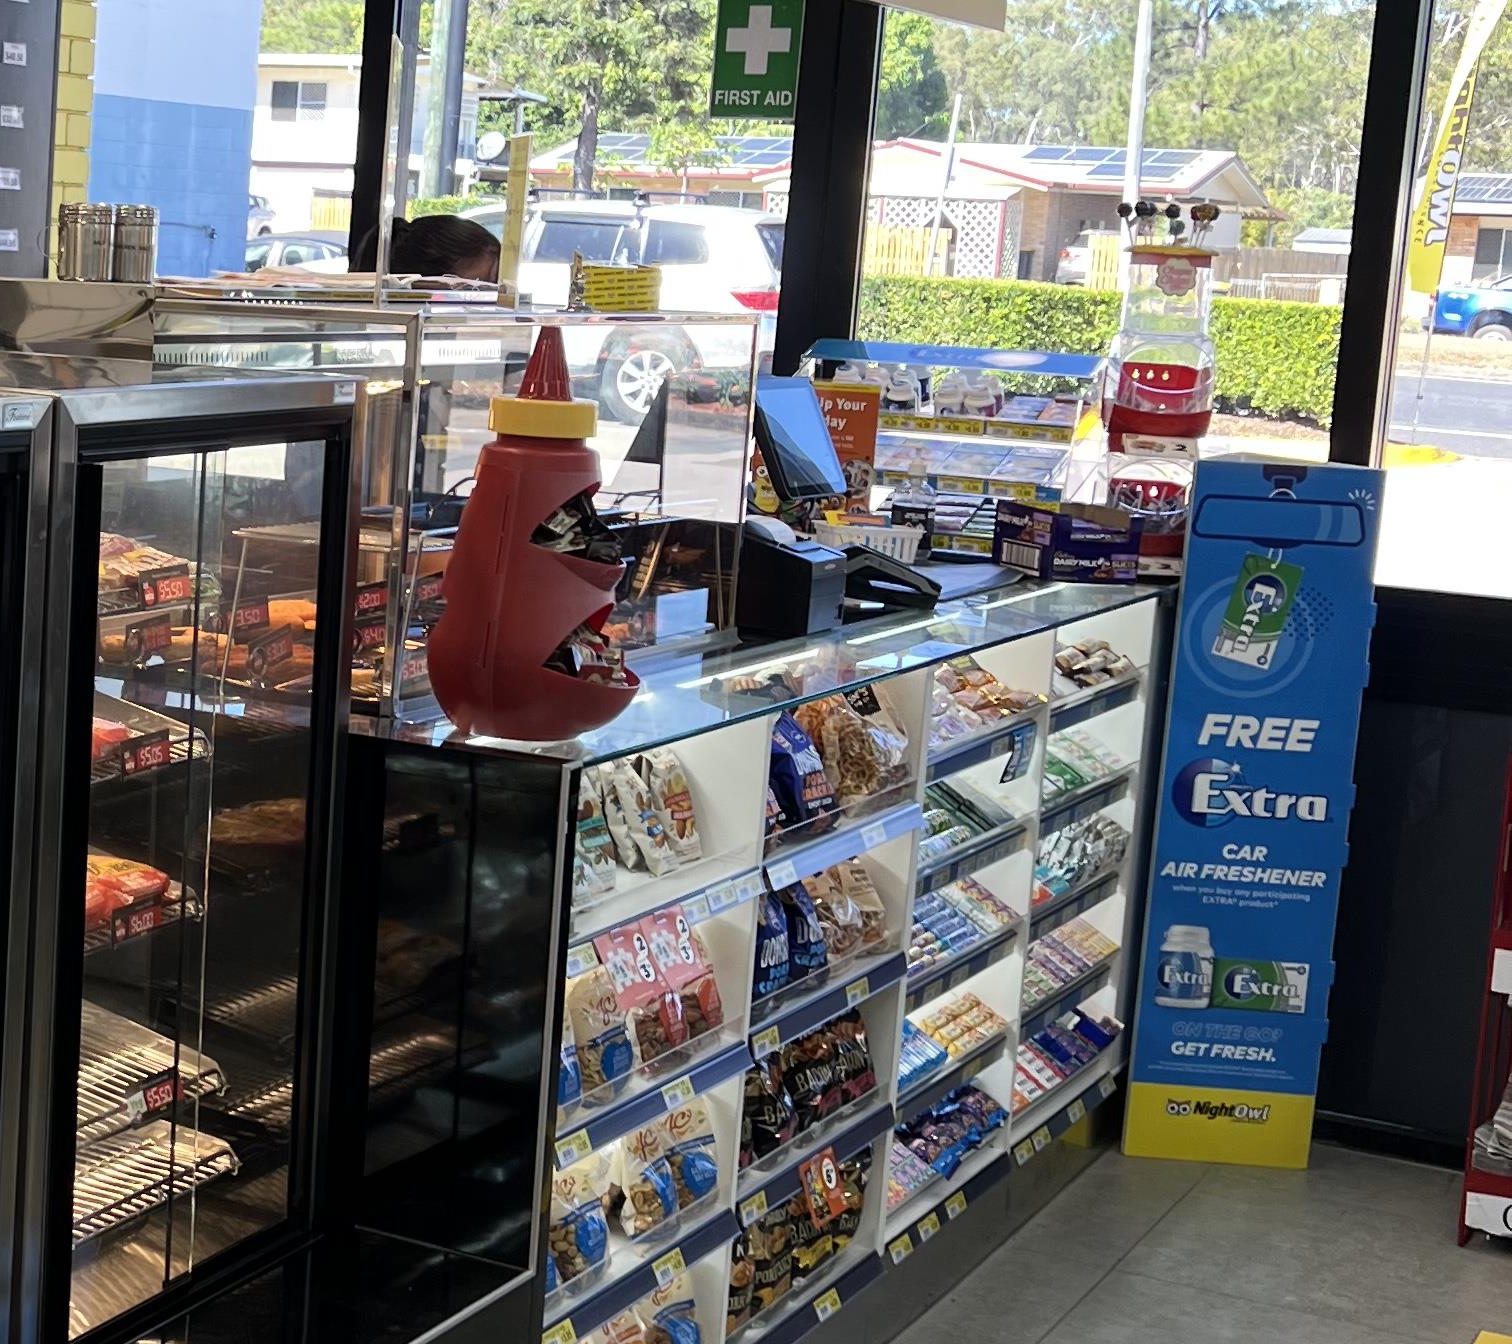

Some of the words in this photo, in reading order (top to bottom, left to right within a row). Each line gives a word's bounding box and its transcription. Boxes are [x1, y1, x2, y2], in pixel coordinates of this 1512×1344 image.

[714, 89, 761, 107] FIRST
[764, 90, 792, 107] AID
[836, 397, 867, 412] Your
[1197, 713, 1320, 752] FREE
[1191, 772, 1328, 822] Extra
[1222, 843, 1268, 862] CAR
[1160, 861, 1199, 878] AIR
[1200, 863, 1327, 888] FRESHENER
[1163, 965, 1210, 986] Extra
[1233, 973, 1298, 998] Extra
[1172, 1021, 1203, 1038] ON
[1205, 1022, 1243, 1040] THE
[1171, 1041, 1209, 1057] GET
[1210, 1043, 1277, 1063] FRESH.
[1193, 1101, 1272, 1121] NightOwl
